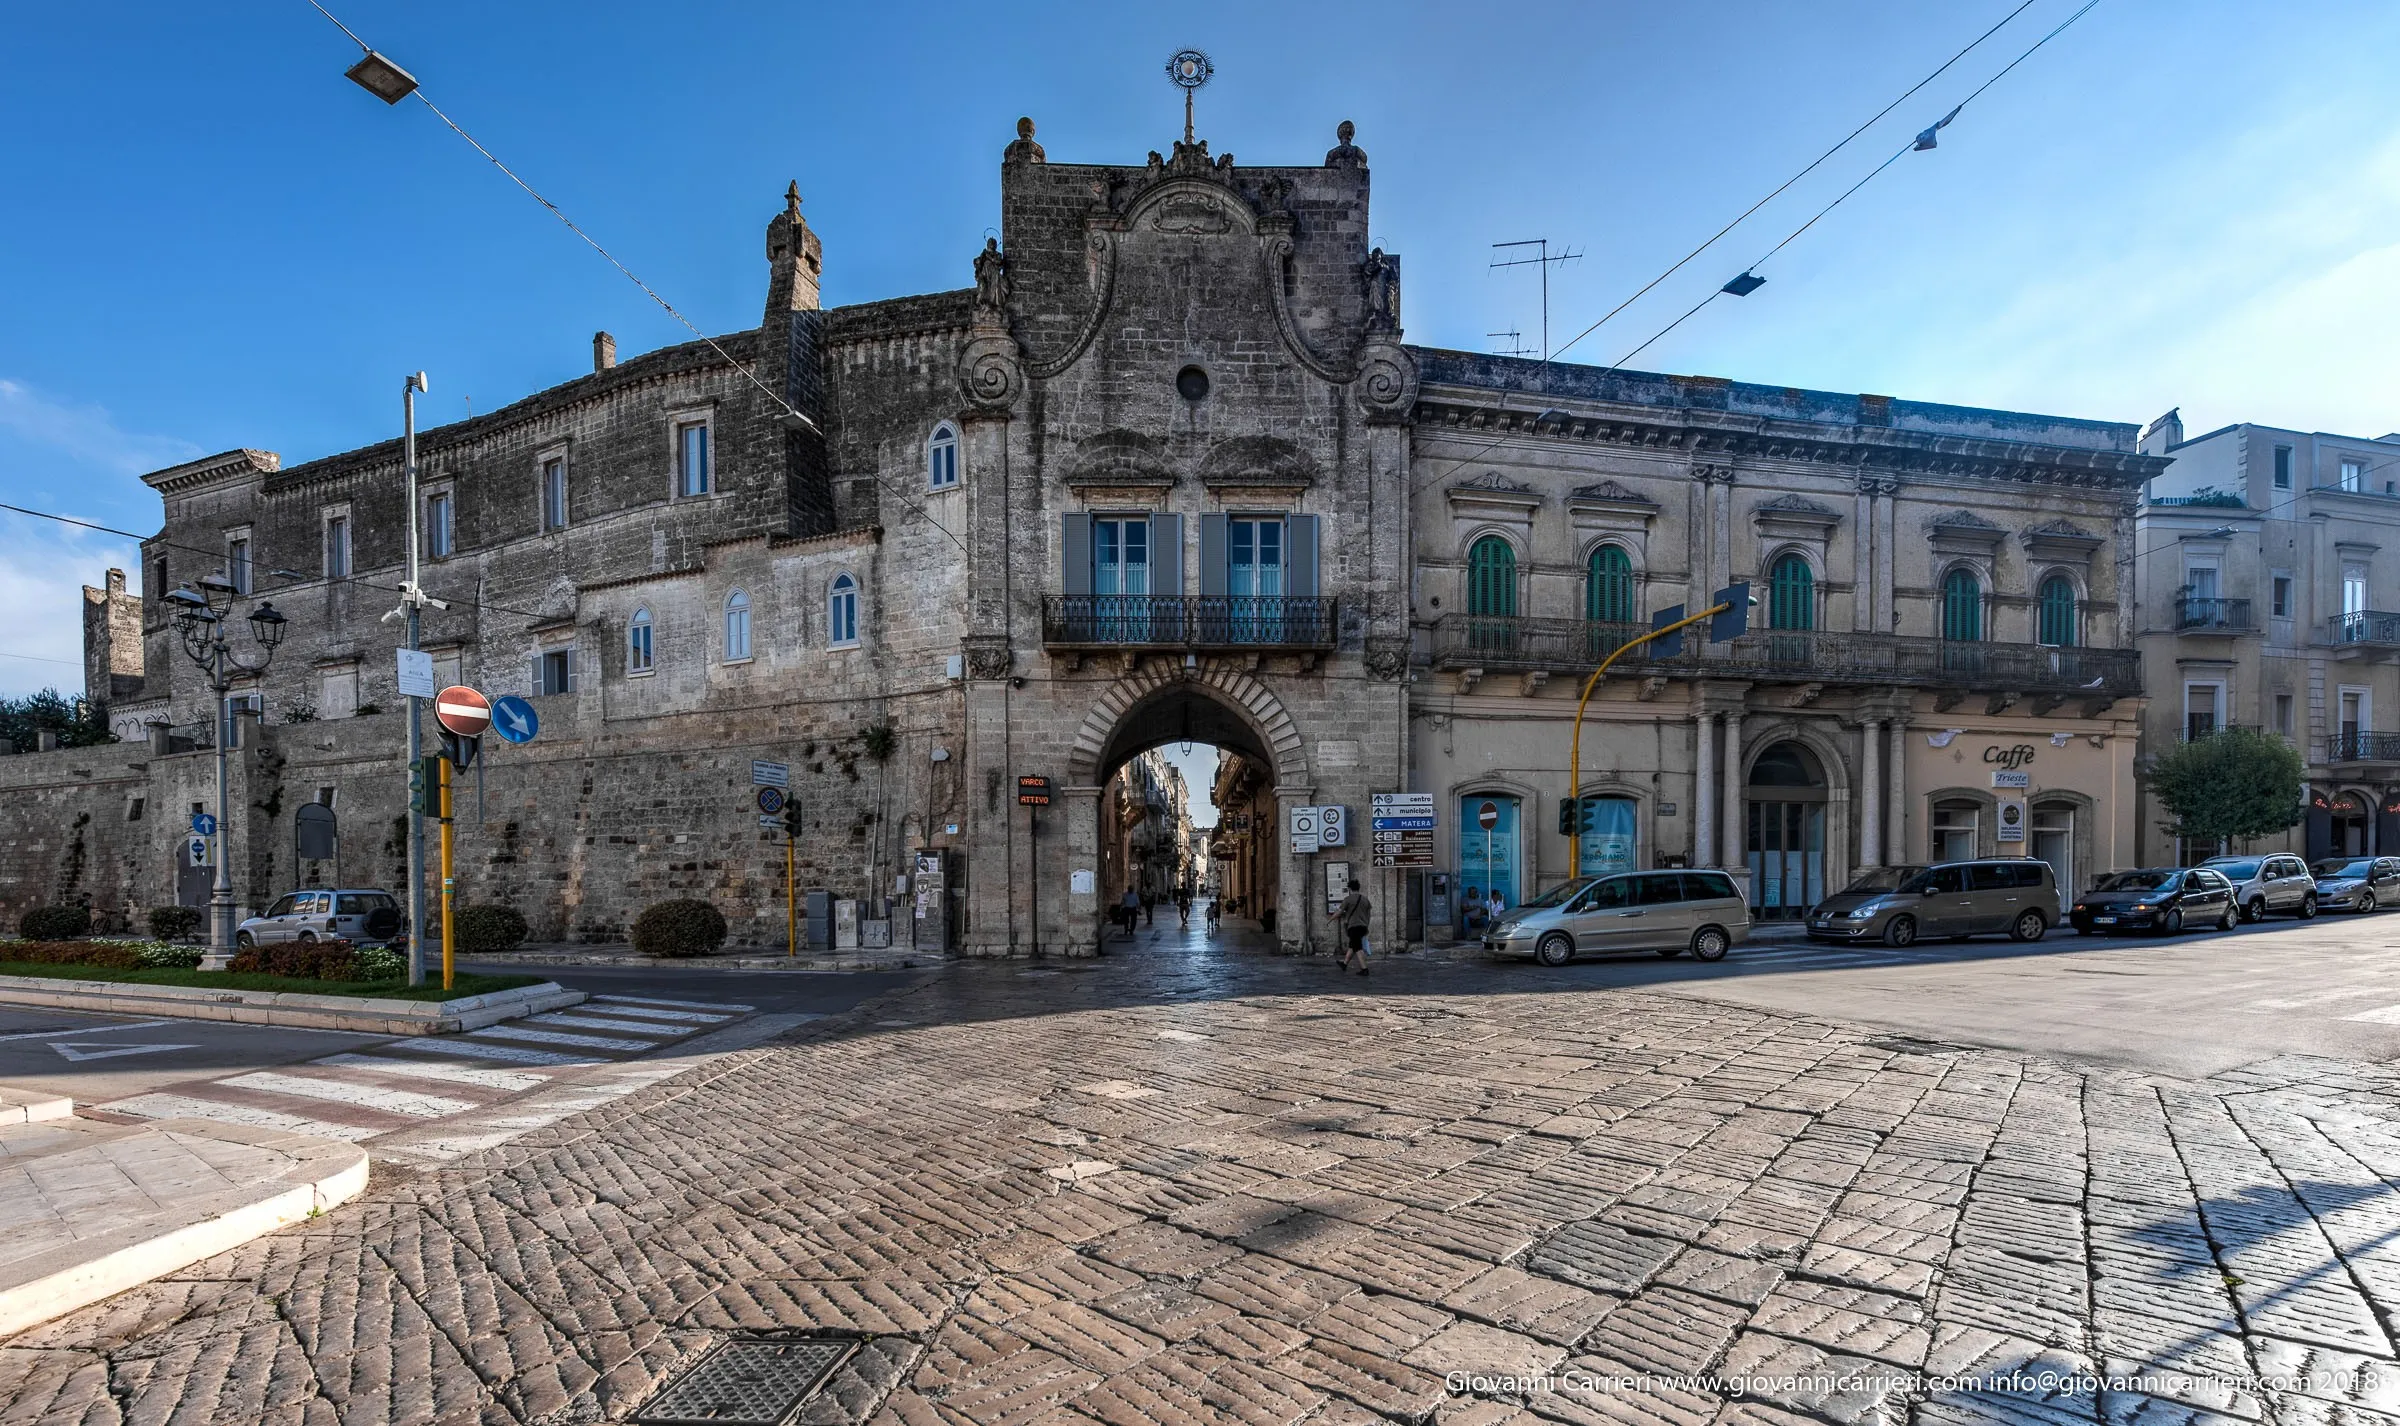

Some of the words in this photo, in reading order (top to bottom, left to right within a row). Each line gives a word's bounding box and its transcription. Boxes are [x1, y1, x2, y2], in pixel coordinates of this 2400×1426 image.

[1983, 744, 2035, 770] Caffè
[1020, 778, 1044, 786] VARCO
[1996, 773, 2027, 782] Trieste
[1020, 795, 1049, 804] ATTIVO
[1399, 807, 1431, 815] municipio
